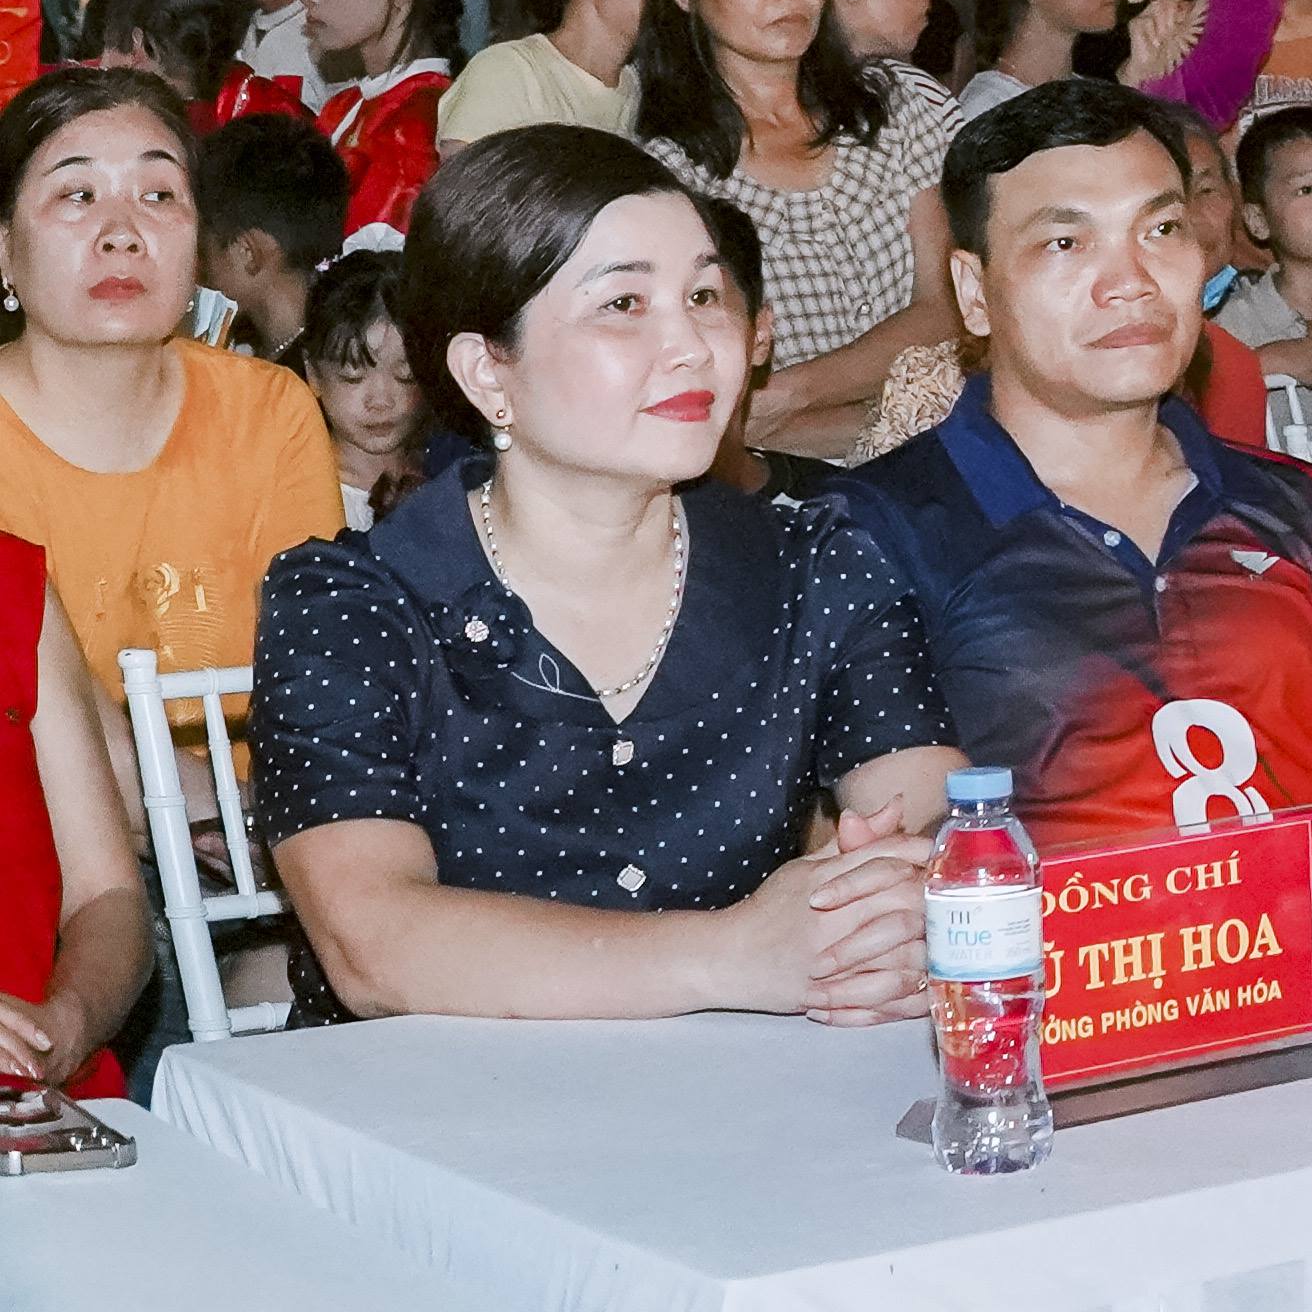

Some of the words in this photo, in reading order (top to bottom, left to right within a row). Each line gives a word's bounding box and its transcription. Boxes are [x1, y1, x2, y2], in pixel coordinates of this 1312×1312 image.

[1151, 698, 1274, 837] 8
[1166, 849, 1243, 895] CHÍ
[947, 927, 993, 946] true
[1078, 932, 1167, 990] THỊ
[1179, 912, 1284, 973] HOA
[1039, 1013, 1094, 1046] ỞNG
[1101, 1000, 1180, 1035] PHÒNG
[1186, 988, 1230, 1017] VĂN
[1237, 976, 1283, 1007] HÓA
